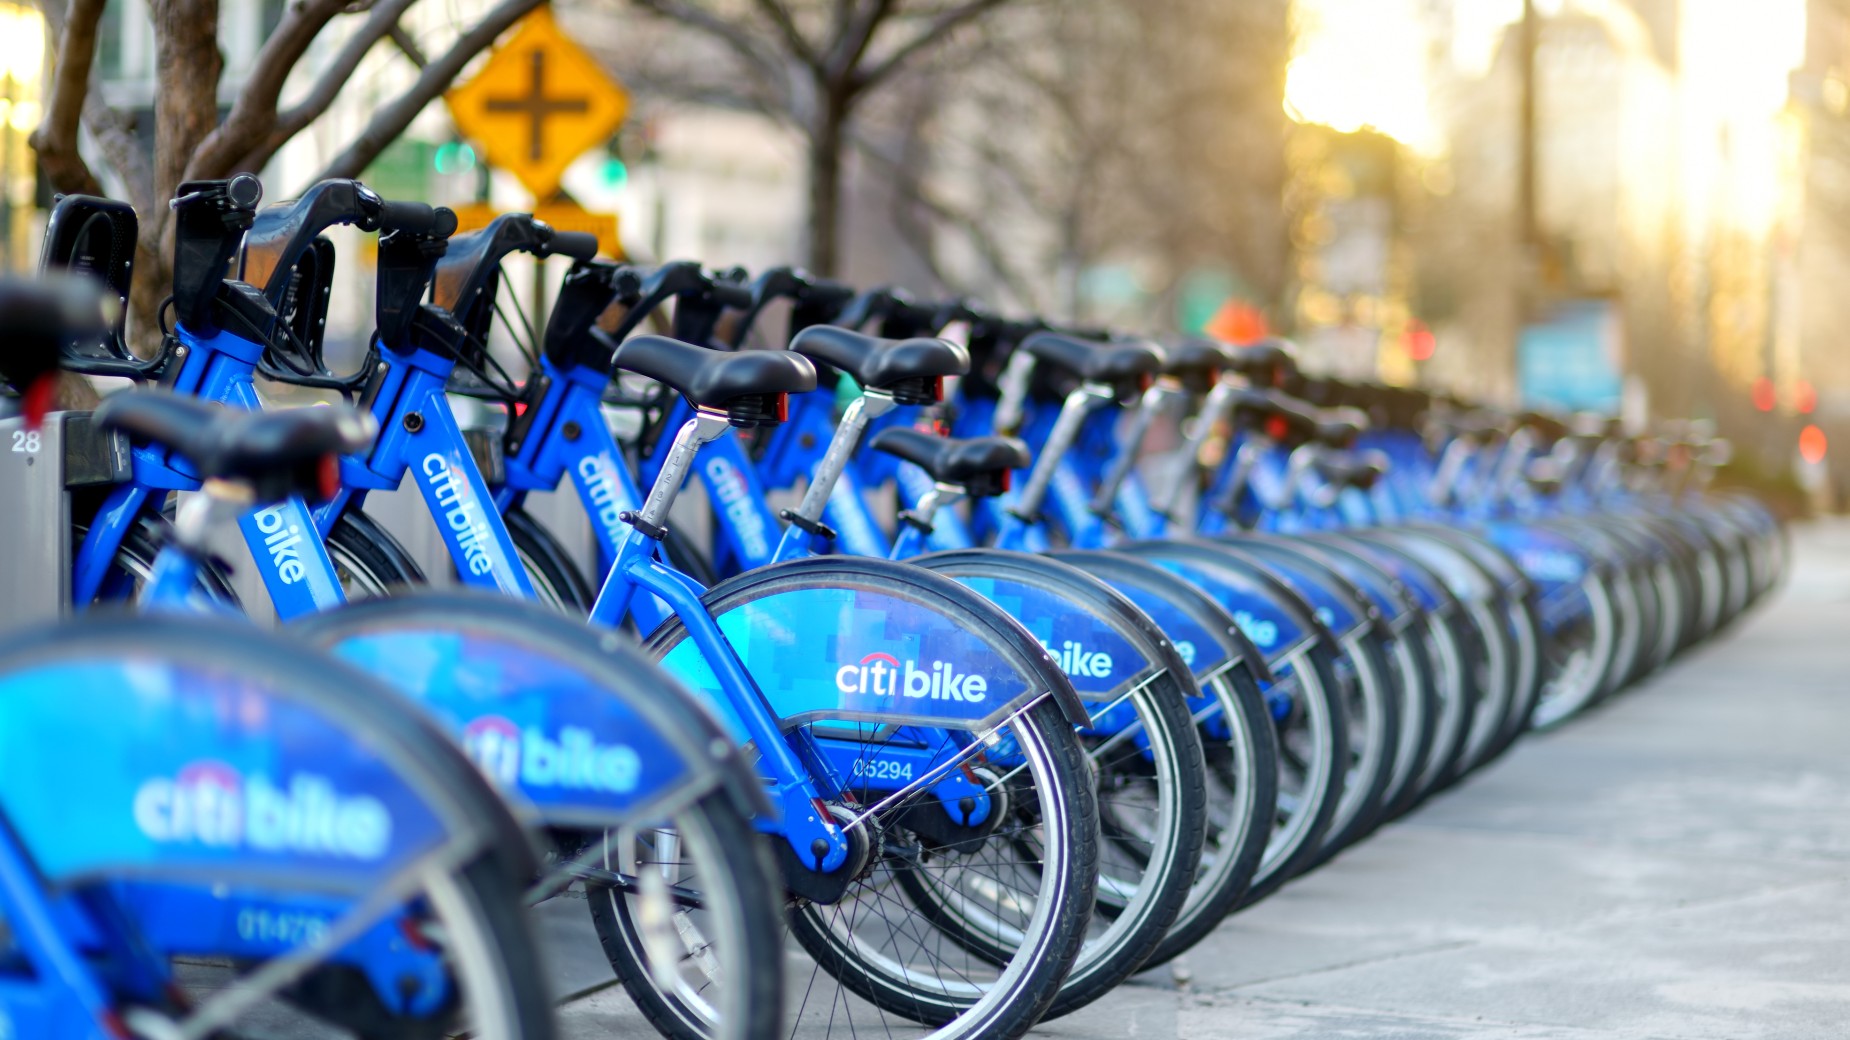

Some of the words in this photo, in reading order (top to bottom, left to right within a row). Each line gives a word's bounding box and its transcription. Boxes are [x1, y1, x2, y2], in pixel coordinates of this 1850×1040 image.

[12, 430, 40, 453] 28
[422, 452, 469, 507] citi
[253, 503, 305, 585] bike
[445, 501, 492, 577] bike
[836, 652, 899, 696] citi
[903, 660, 987, 702] bike
[522, 728, 641, 794] bike
[853, 758, 912, 780] 05294
[132, 760, 243, 846] citi
[245, 773, 392, 862] bike
